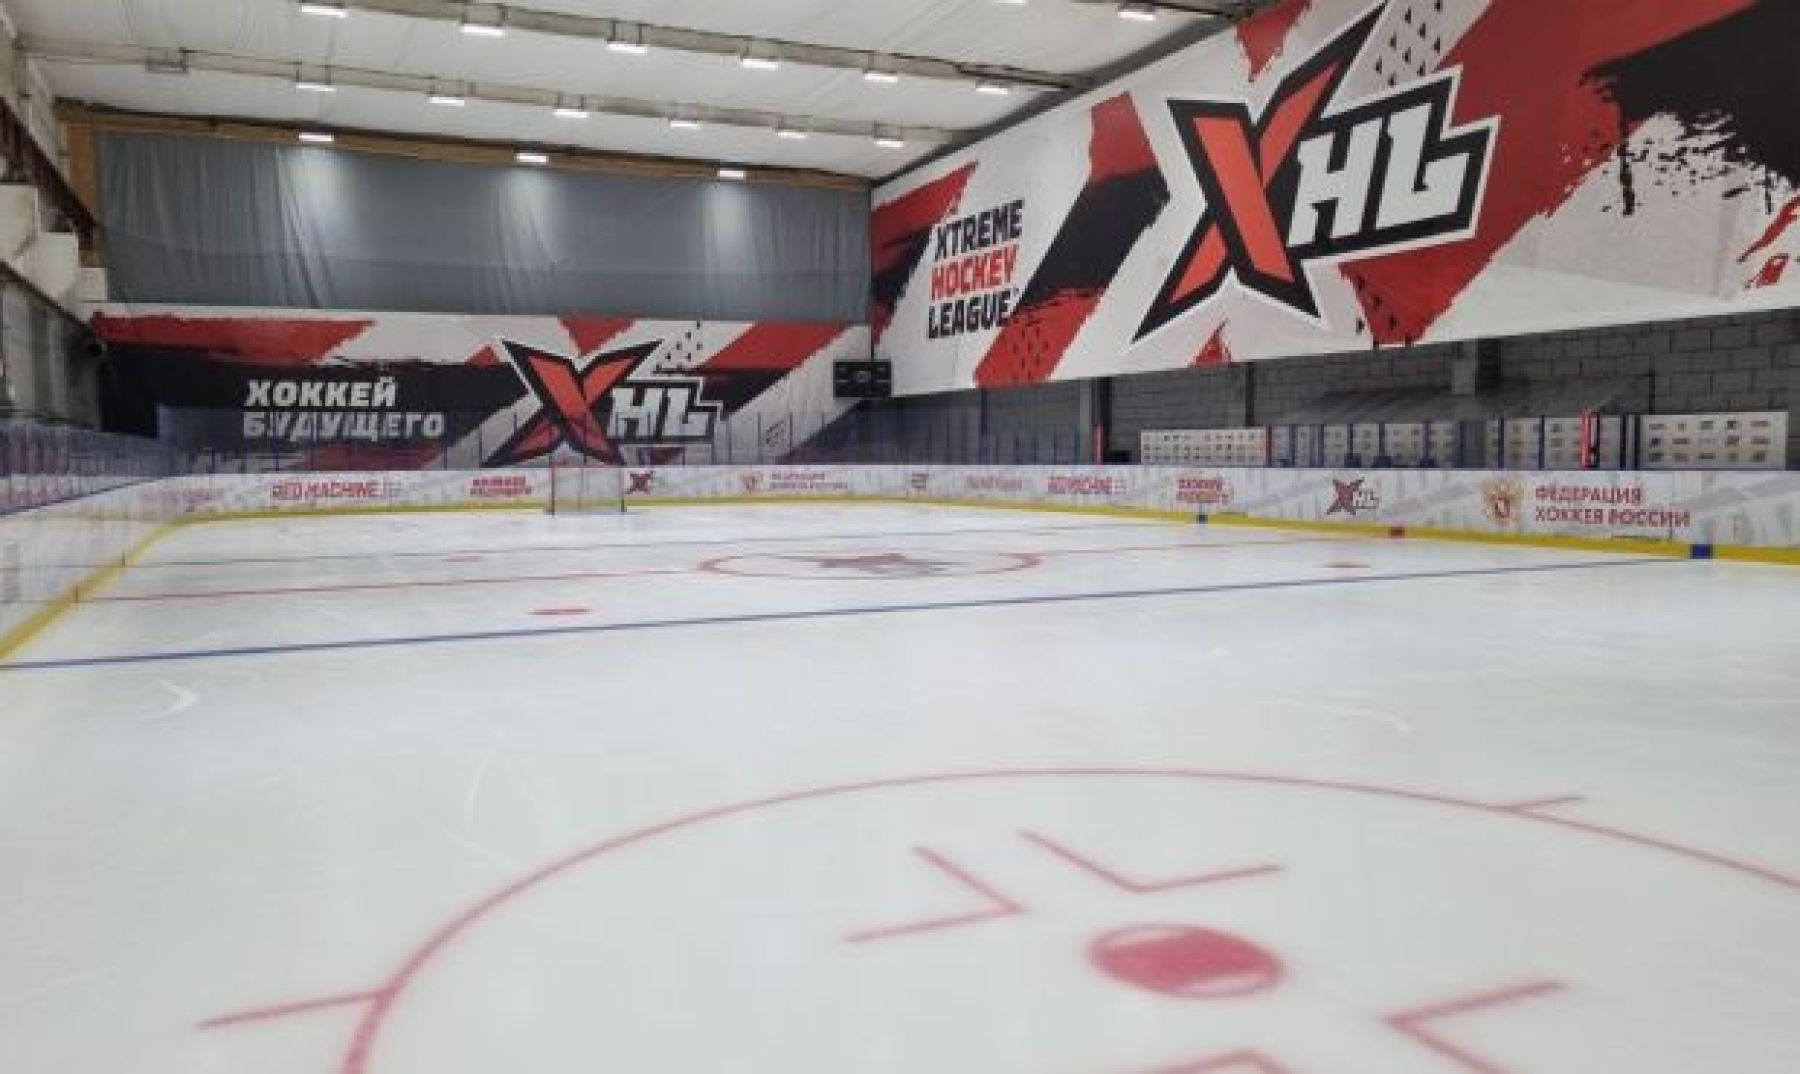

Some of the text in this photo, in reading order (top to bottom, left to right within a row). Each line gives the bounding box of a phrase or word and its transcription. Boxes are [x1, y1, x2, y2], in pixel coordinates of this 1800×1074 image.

[1132, 2, 1492, 342] XHL
[933, 199, 1024, 262] XTREME
[931, 244, 1019, 301] HOCKEY
[246, 376, 396, 407] ХОККЕЙ
[483, 340, 716, 466] XHL
[243, 411, 445, 441] БУДУЩЕГО
[1535, 484, 1642, 505] ФЕДЕРАЦИЯ
[1535, 505, 1691, 528] ХОККЕЯ РОССИИ
